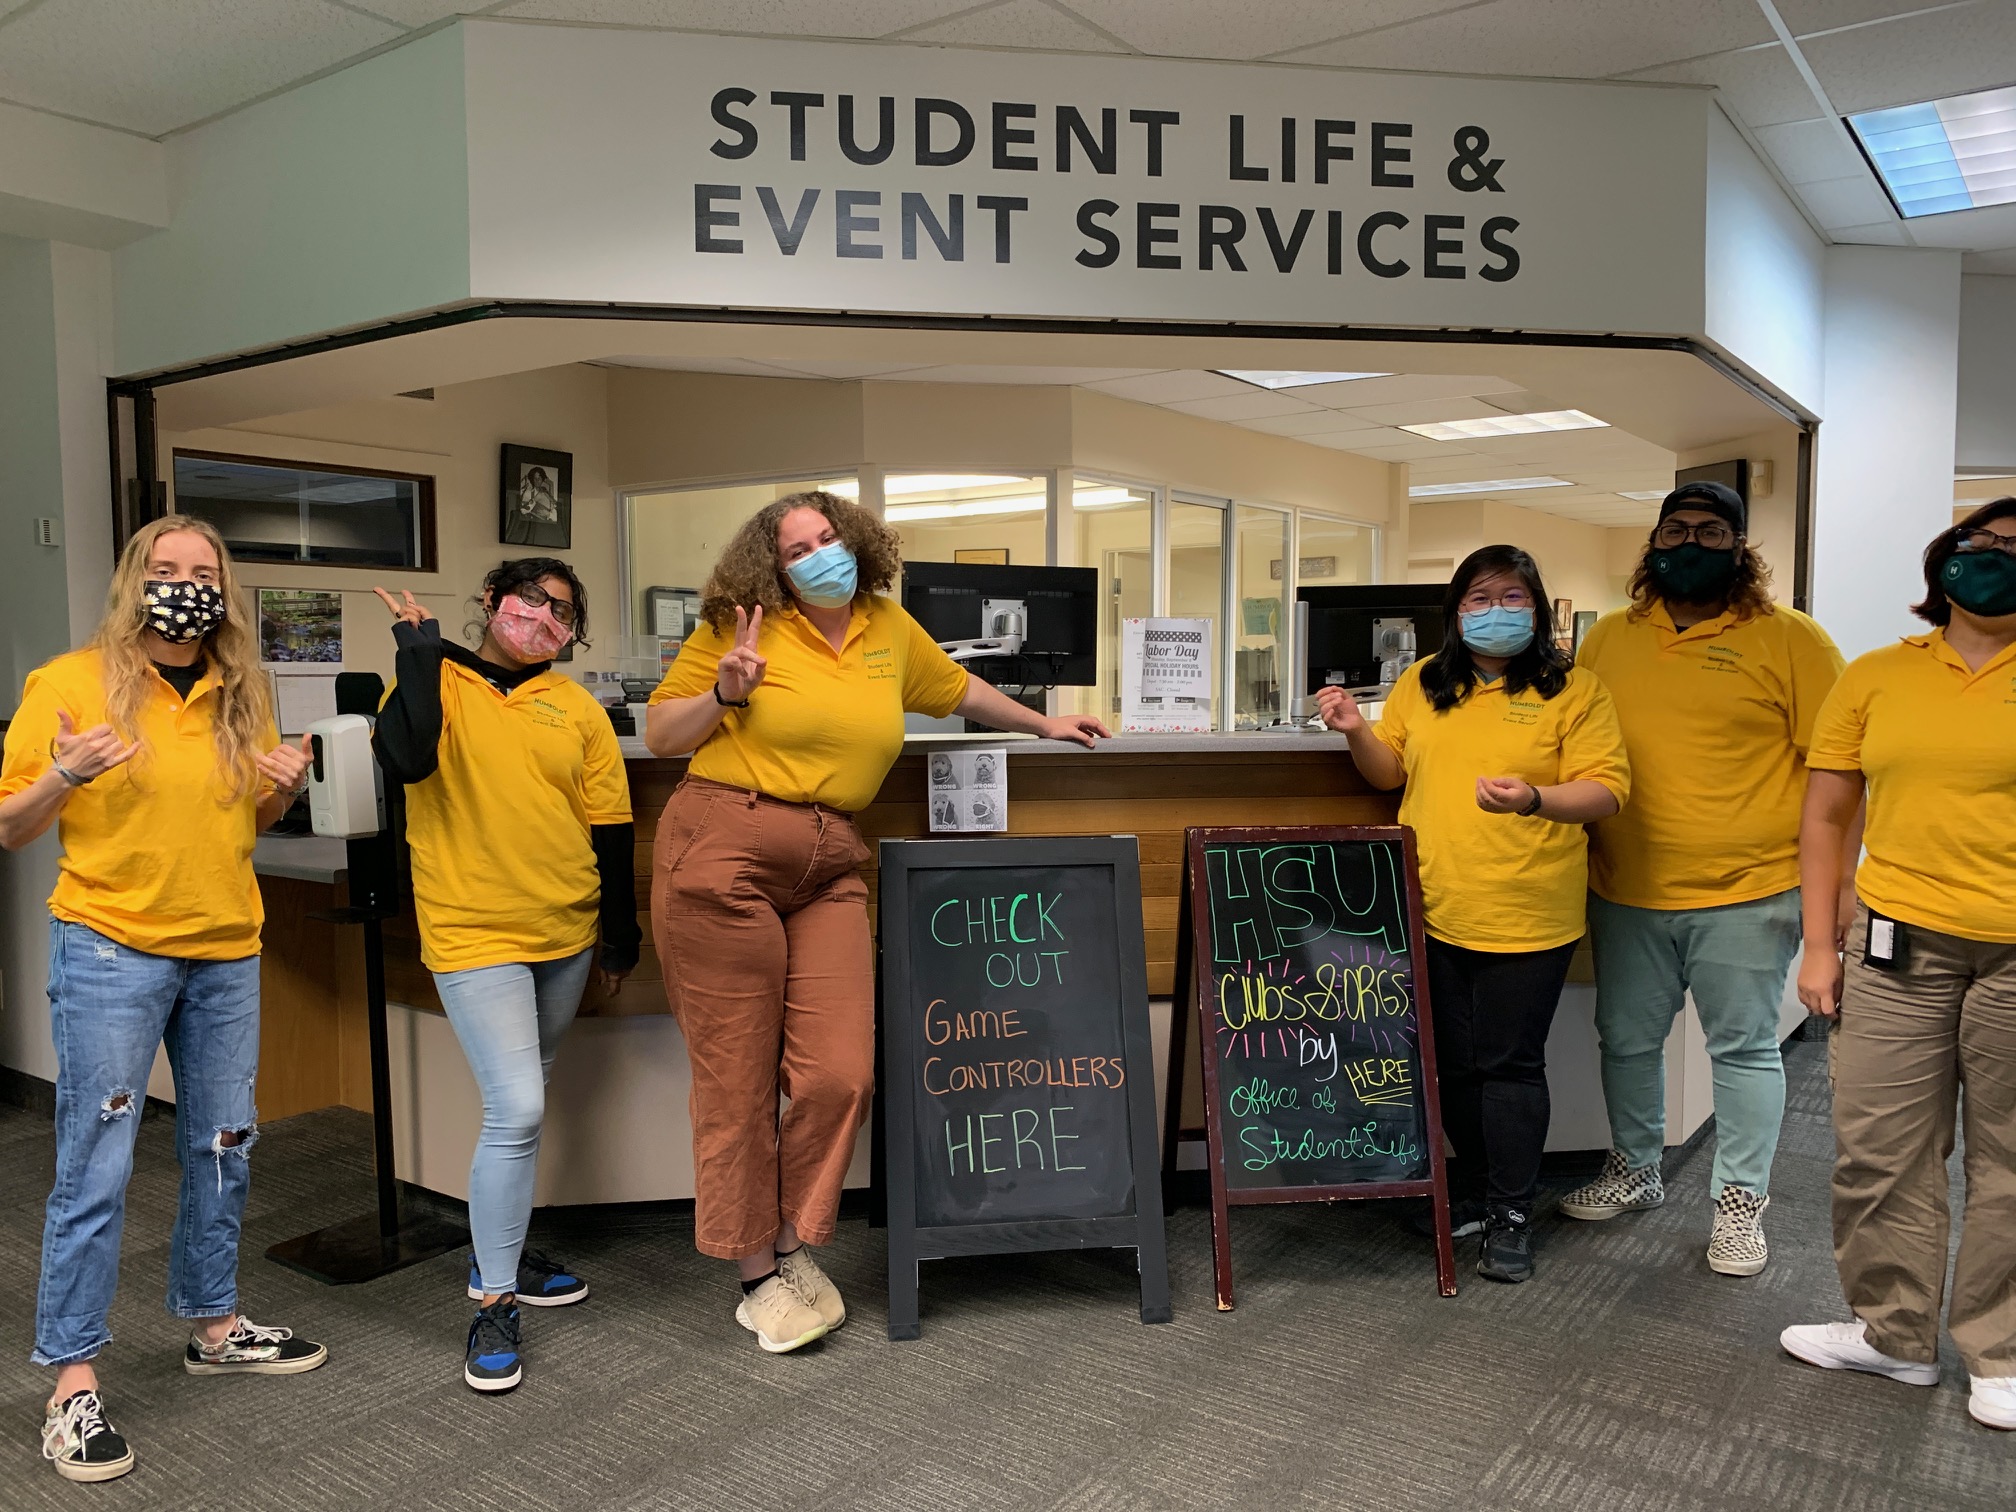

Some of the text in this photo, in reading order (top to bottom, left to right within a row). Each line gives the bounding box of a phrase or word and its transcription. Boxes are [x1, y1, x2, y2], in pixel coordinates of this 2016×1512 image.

[709, 87, 1506, 193] STUDENT LIFE &
[694, 184, 1521, 284] EVENT SERVICES
[1174, 644, 1199, 661] Day
[534, 697, 567, 715] HUMBOLDT
[1509, 700, 1545, 710] HUMBOLDT
[931, 892, 1065, 947] CHECK
[1204, 842, 1407, 963] HSU
[986, 951, 1069, 988] OUT
[925, 999, 1028, 1046] GAME
[923, 1057, 1126, 1095] CONTROLLERS
[1300, 1028, 1339, 1082] by
[1229, 1077, 1337, 1117] Office of
[1344, 1058, 1412, 1099] HERE
[946, 1106, 1086, 1176] HERE
[1240, 1126, 1363, 1171] Student
